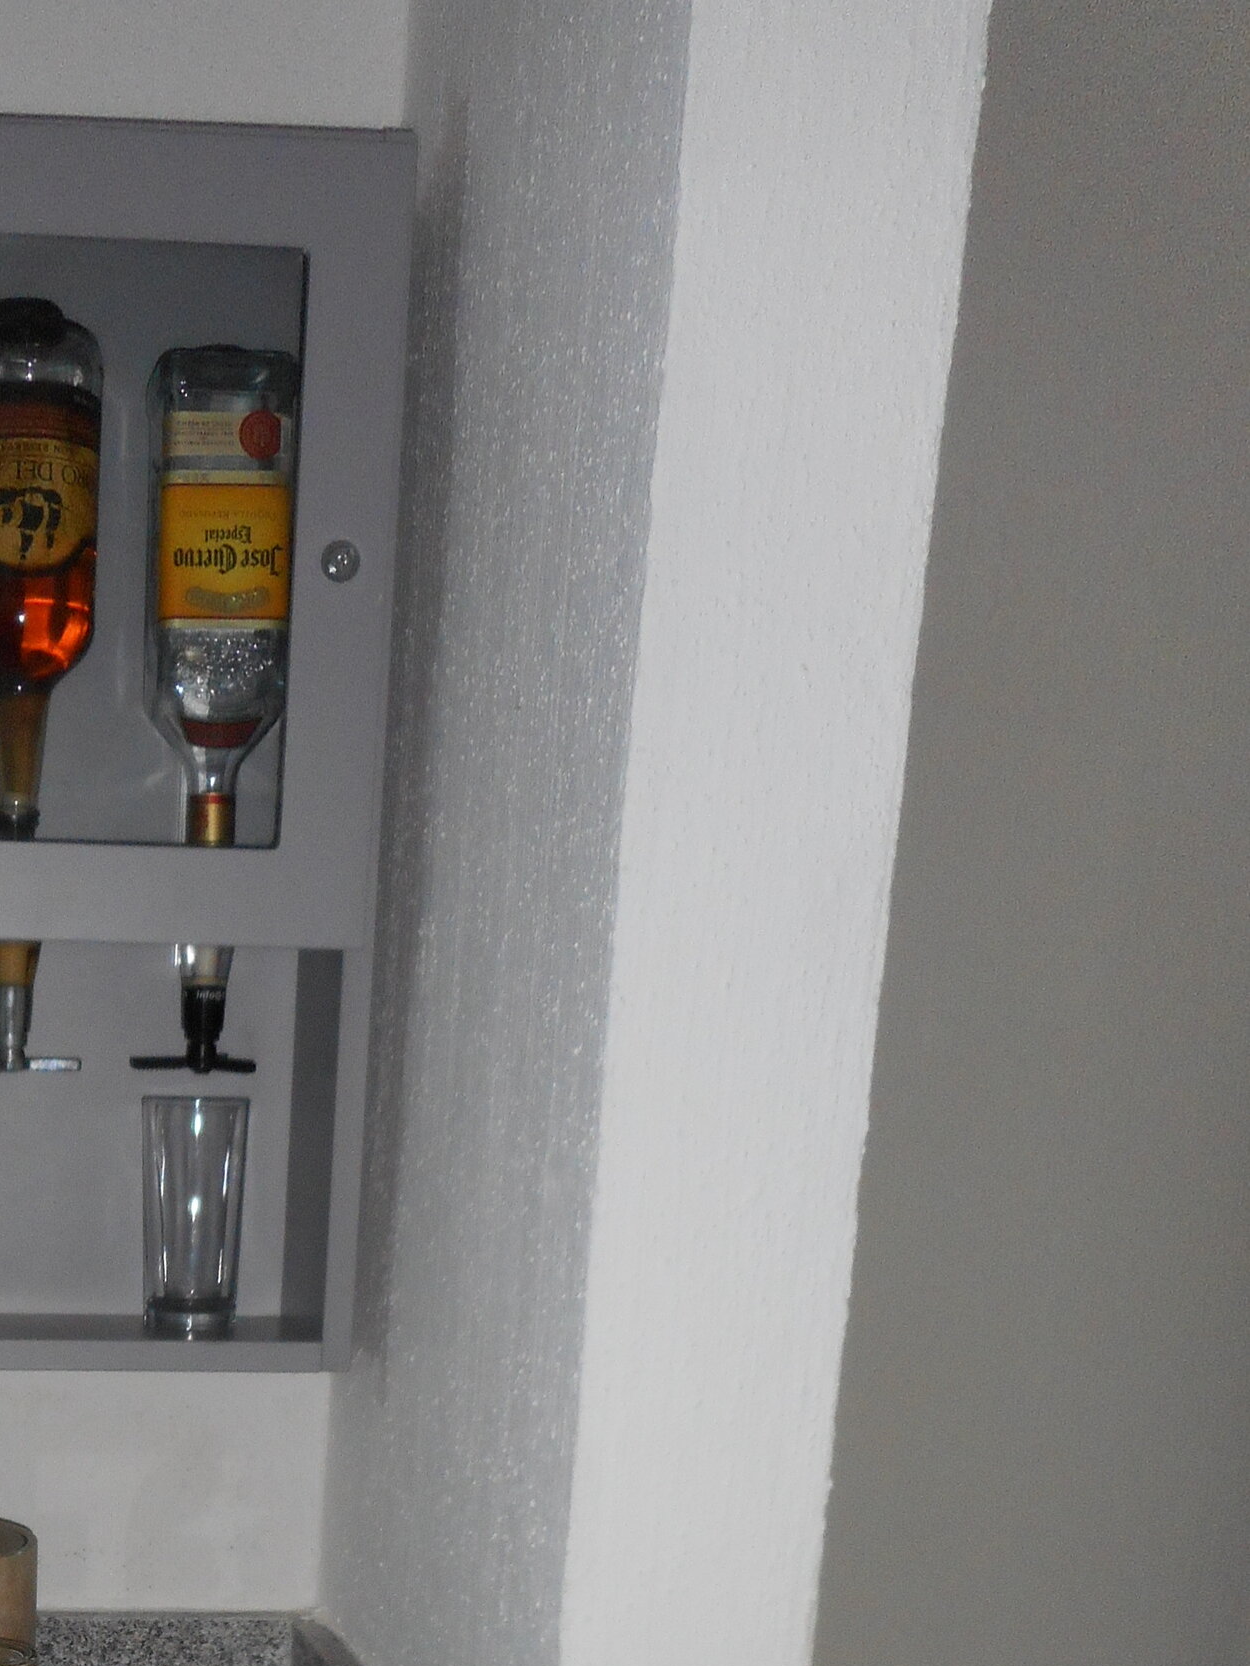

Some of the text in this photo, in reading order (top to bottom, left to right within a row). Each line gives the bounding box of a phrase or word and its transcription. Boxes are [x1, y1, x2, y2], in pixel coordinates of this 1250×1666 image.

[12, 460, 53, 482] DEL
[205, 525, 252, 544] Especial
[173, 544, 283, 577] Jose Cuervo
